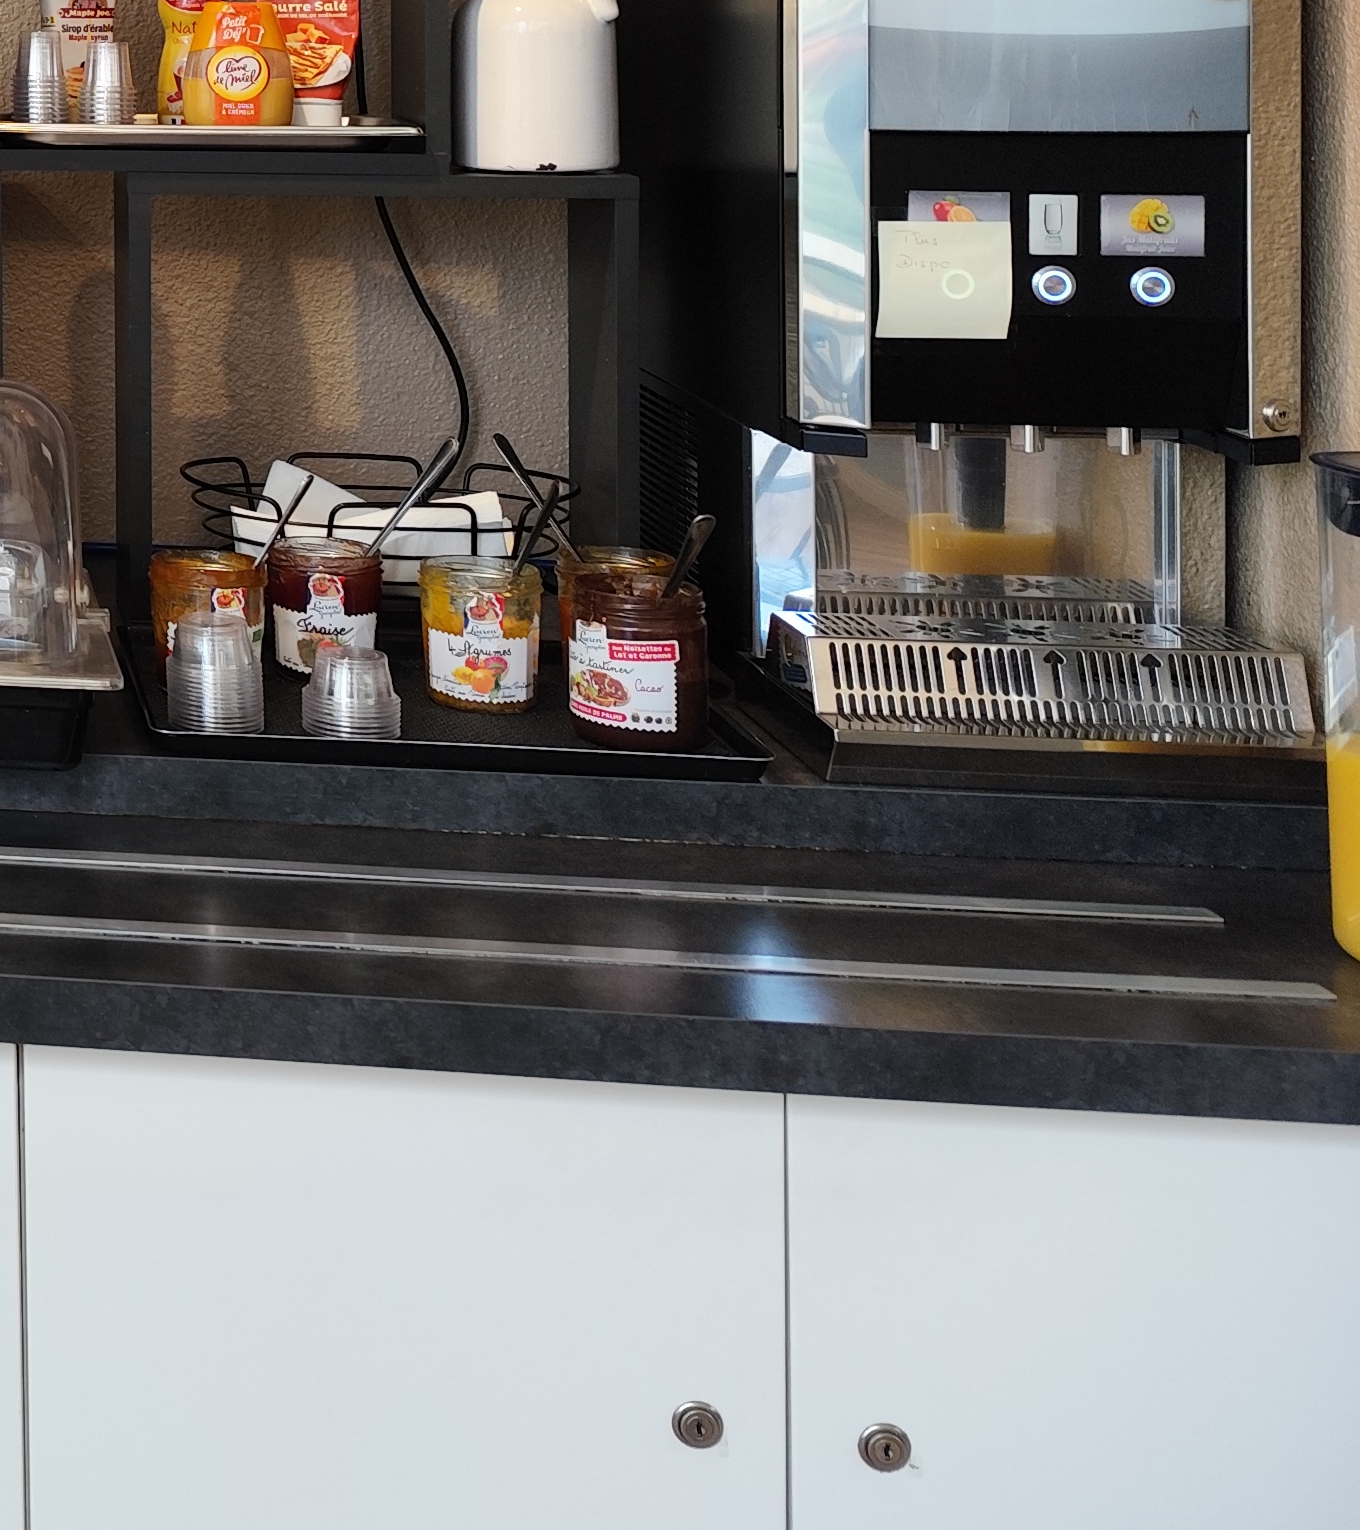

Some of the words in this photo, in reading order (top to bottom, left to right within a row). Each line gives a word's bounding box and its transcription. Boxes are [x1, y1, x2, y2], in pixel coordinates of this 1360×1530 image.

[272, 3, 311, 13] eurre
[315, 1, 347, 12] Salé
[172, 21, 197, 34] Nat
[221, 15, 248, 28] Petit
[61, 24, 81, 34] Sirop
[83, 24, 114, 33] d'érable
[68, 34, 88, 42] Maple
[896, 254, 951, 272] Dispo
[296, 617, 354, 636] Fraise
[447, 638, 456, 655] 4
[460, 640, 512, 664] Agrumes
[585, 658, 634, 674] tartiner
[635, 678, 664, 693] Cacao
